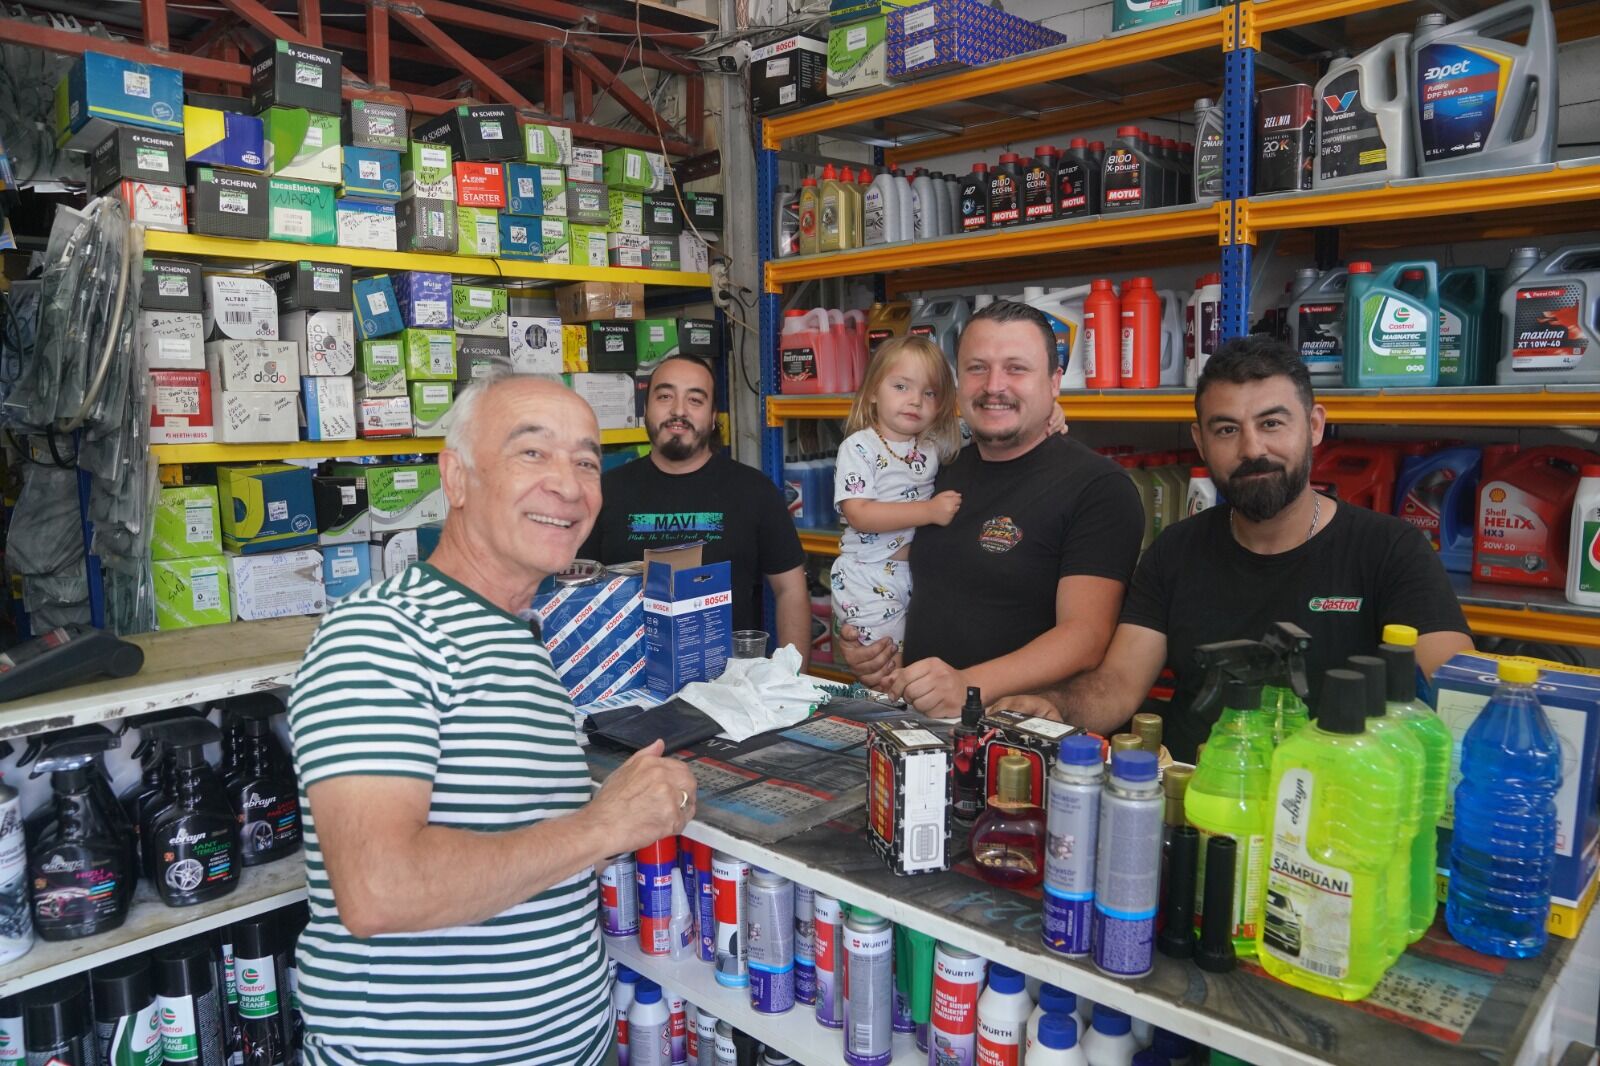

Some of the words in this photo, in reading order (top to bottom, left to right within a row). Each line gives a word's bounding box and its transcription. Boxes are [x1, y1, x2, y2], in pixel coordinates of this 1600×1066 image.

[775, 39, 796, 52] BOSCH
[296, 50, 332, 65] SCHENNA
[1443, 87, 1468, 97] 5W-30
[478, 110, 505, 118] SCHENNA
[1324, 111, 1356, 122] Valvoline
[427, 123, 452, 139] SCHENNA
[141, 136, 174, 147] SCHENNA
[1108, 153, 1132, 164] 8100
[1106, 163, 1140, 173] X-power
[1026, 170, 1045, 181] 8100
[220, 178, 257, 189] SCHENNA
[270, 180, 321, 194] LucasElektrik
[991, 177, 1010, 188] 8100
[463, 193, 500, 201] STARTER
[866, 193, 879, 201] Mobil
[1108, 189, 1140, 200] MOTUL
[1062, 197, 1084, 207] MOTUL
[993, 210, 1018, 221] MOTUL
[1027, 205, 1052, 215] MOTUL
[964, 217, 985, 226] MOTUL
[160, 265, 191, 274] SCHENNA
[316, 266, 344, 274] SCHENNA
[255, 326, 275, 336] dodo
[1519, 329, 1565, 339] maxima
[1302, 340, 1336, 349] maxima
[1530, 340, 1561, 348] 10W-40
[471, 347, 501, 355] SCHENNA
[253, 372, 287, 384] dodo
[1485, 508, 1507, 516] Shell
[654, 515, 696, 530] MAVI
[1484, 515, 1536, 530] HELIX
[1484, 529, 1505, 538] HX3
[1483, 541, 1516, 551] 20W-50
[704, 593, 729, 606] BOSCH
[541, 597, 561, 617] BOSCH
[652, 603, 670, 612] BOSCH
[1321, 600, 1359, 611] Castrol
[574, 605, 593, 625] BOSCH
[605, 612, 624, 632] BOSCH
[570, 644, 590, 664] BOSCH
[601, 651, 620, 670] BOSCH
[243, 793, 277, 808] ebrayn
[169, 828, 206, 844] ebrayn
[239, 984, 265, 992] Castrol
[240, 1000, 271, 1009] CLEANER
[162, 1025, 183, 1033] astrol
